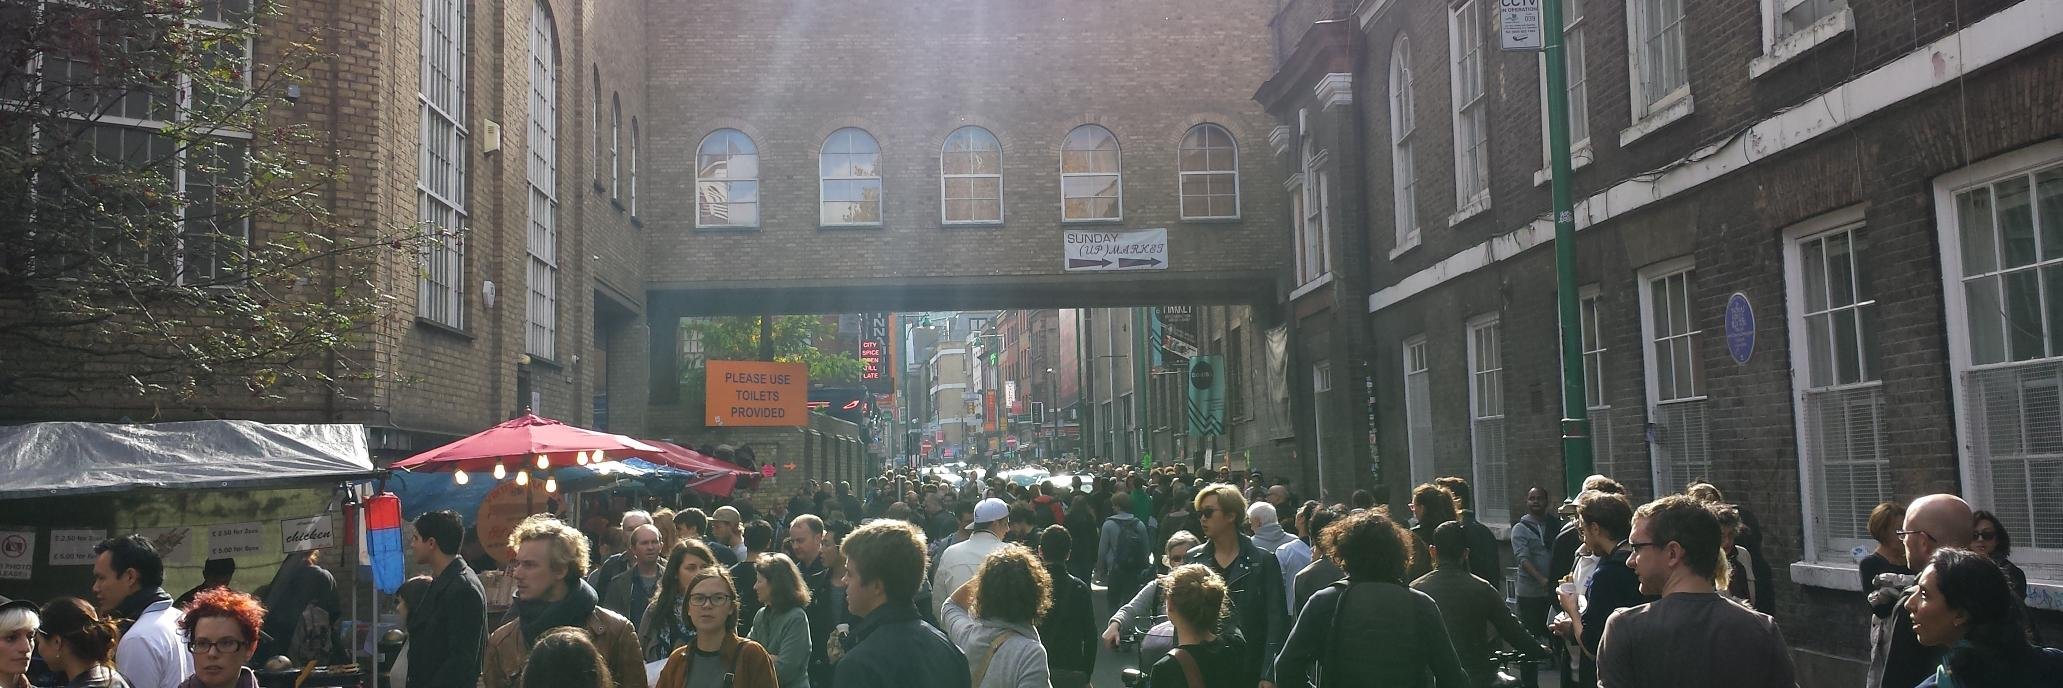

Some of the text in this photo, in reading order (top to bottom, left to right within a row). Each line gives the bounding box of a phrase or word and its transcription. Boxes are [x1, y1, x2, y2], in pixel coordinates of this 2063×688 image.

[1067, 233, 1118, 244] SUNDAY
[725, 372, 791, 385] PLEASE USE
[736, 390, 780, 401] TOILETS
[731, 407, 785, 418] PROVIDED
[286, 528, 331, 543] chicken
